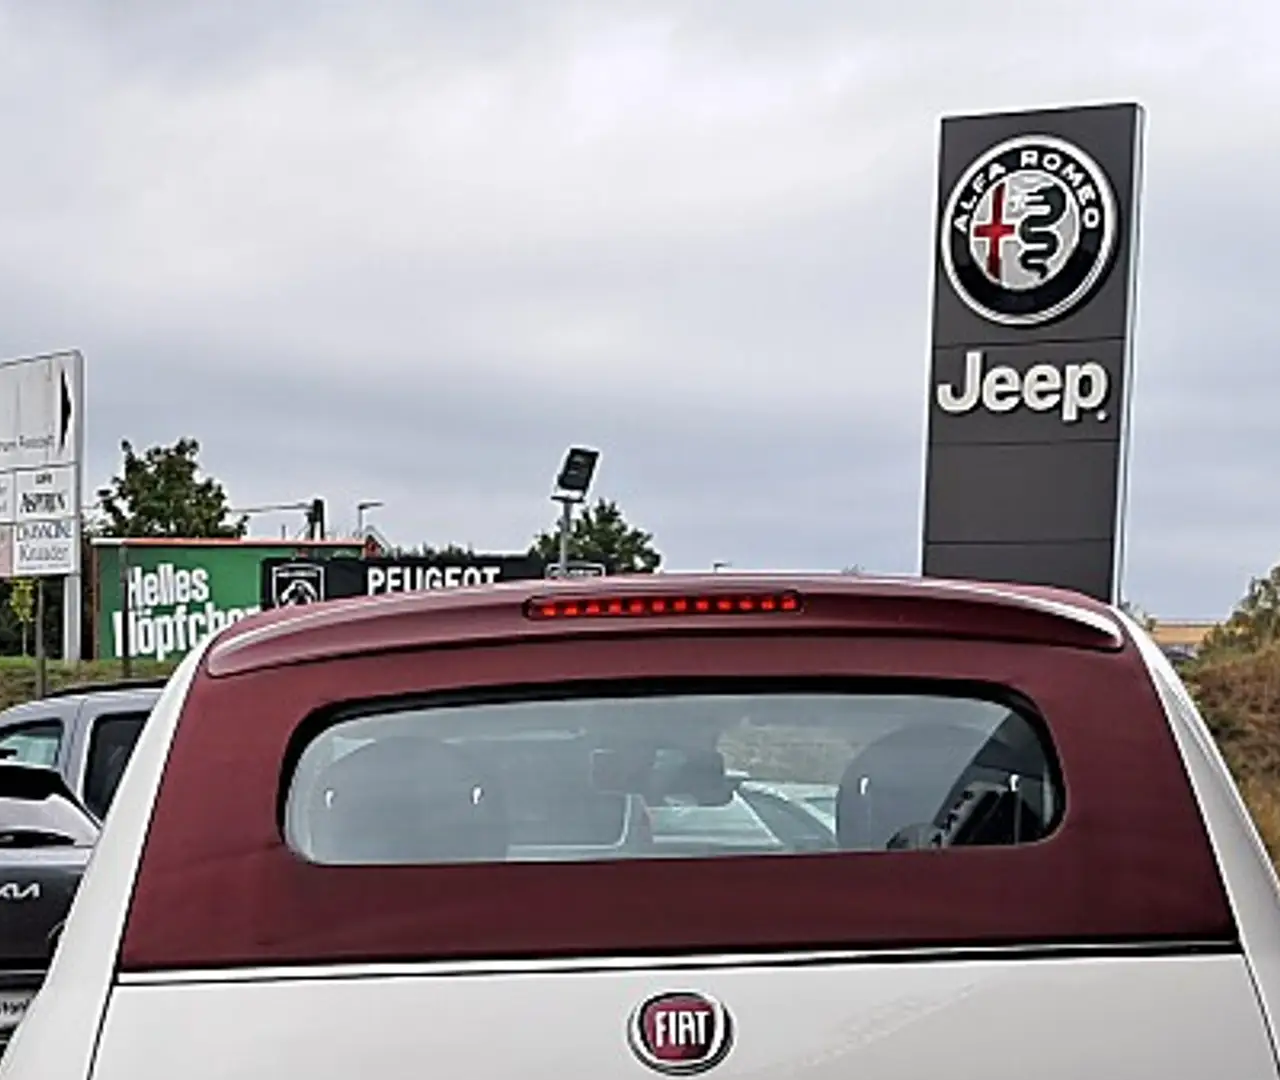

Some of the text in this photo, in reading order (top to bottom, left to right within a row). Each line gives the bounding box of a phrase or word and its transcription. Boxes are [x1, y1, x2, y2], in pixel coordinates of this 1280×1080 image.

[952, 149, 1101, 232] ALFA ROMEO
[936, 351, 1109, 421] Jeep
[126, 563, 210, 609] Helles
[655, 1010, 711, 1048] FIAT
